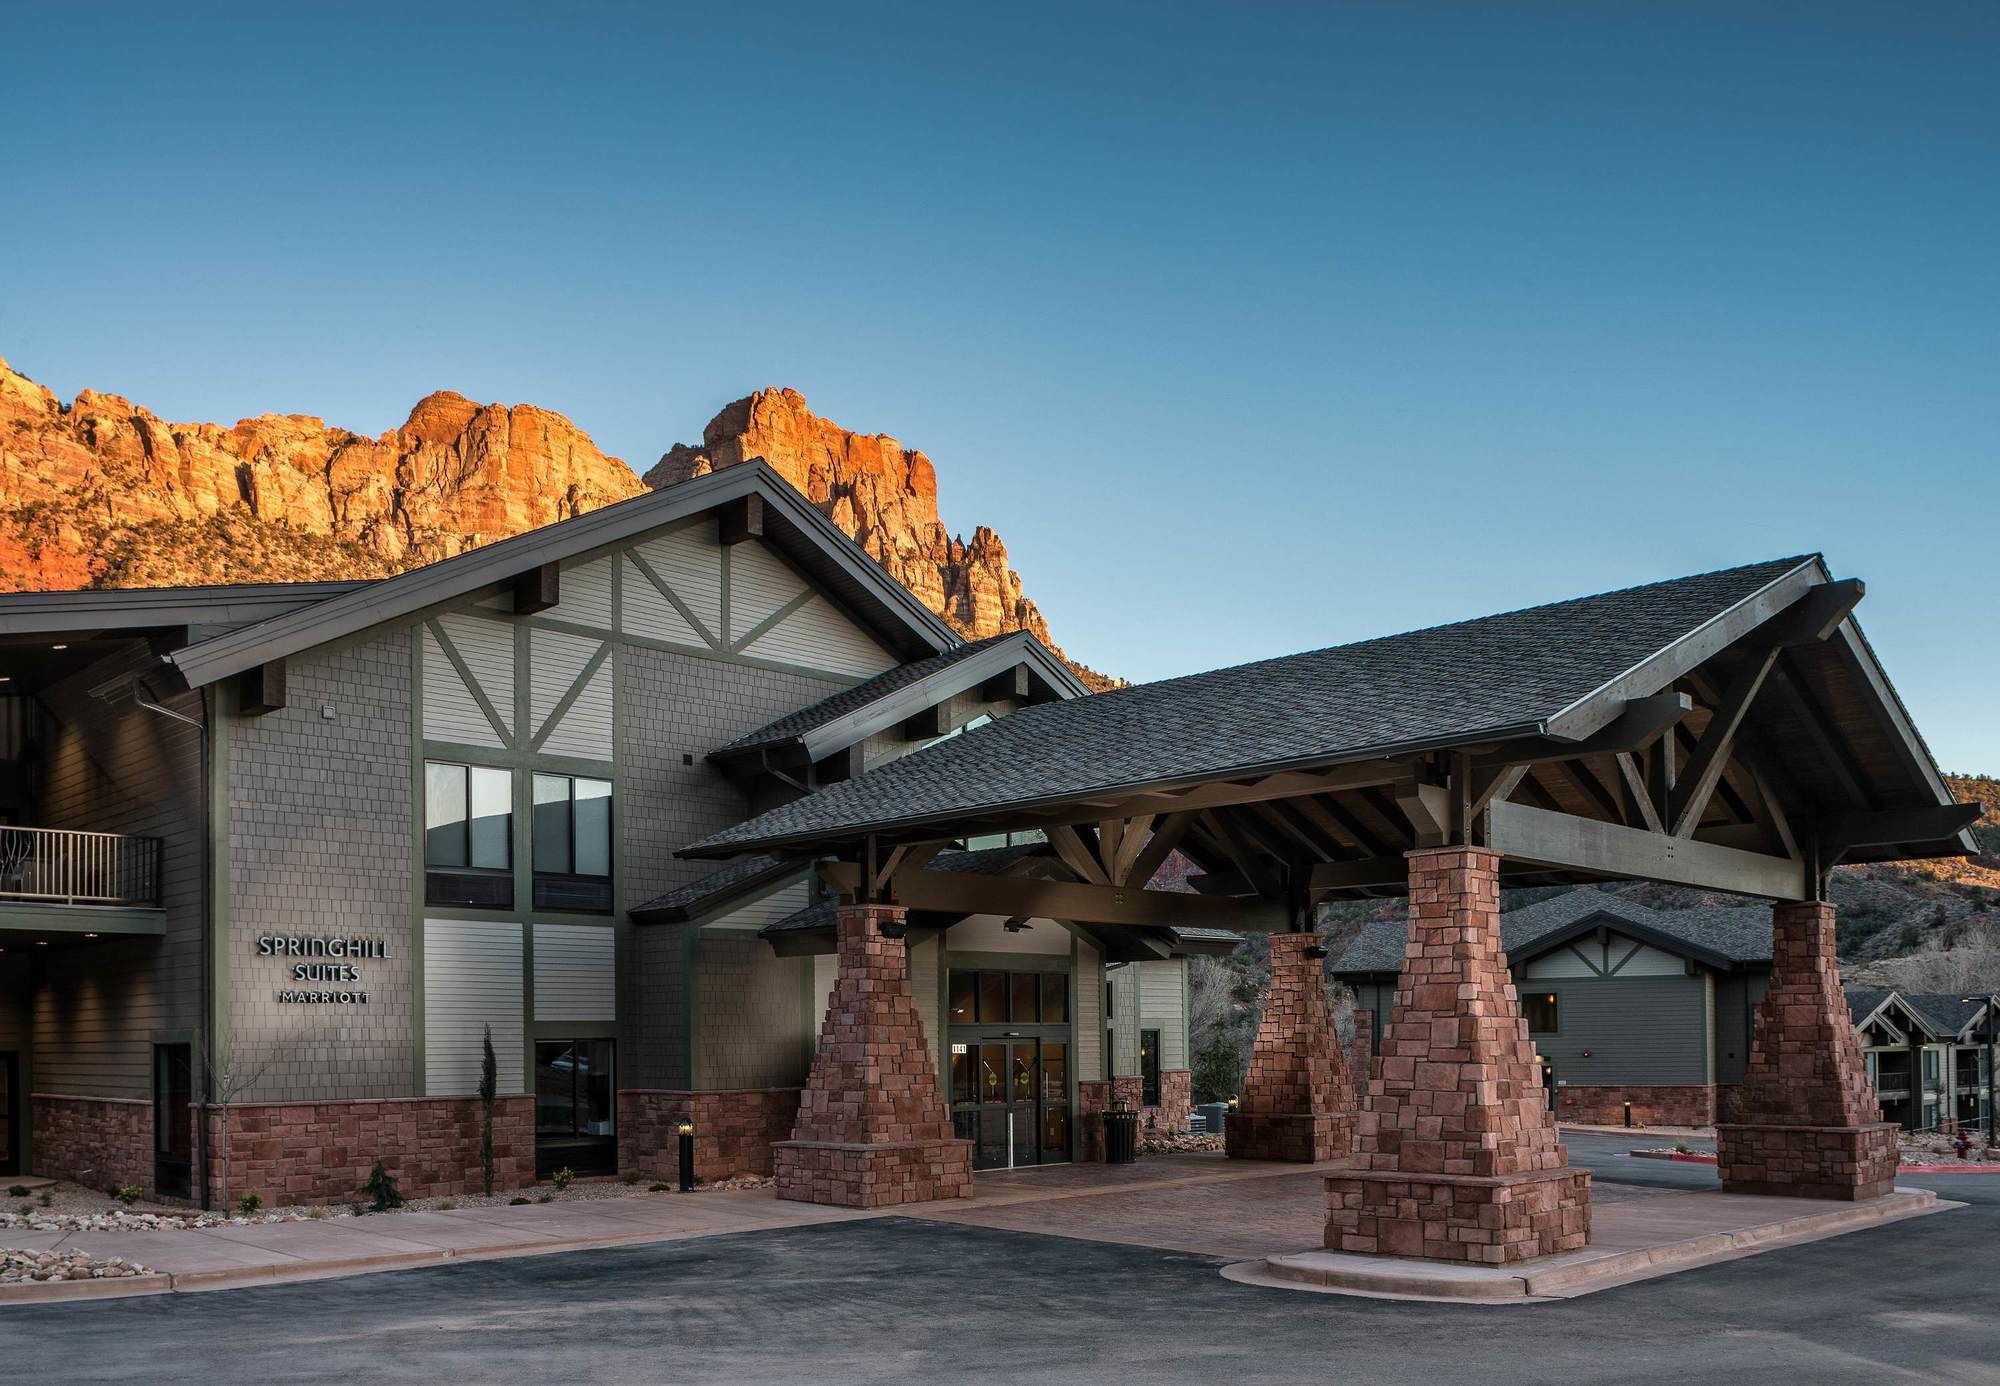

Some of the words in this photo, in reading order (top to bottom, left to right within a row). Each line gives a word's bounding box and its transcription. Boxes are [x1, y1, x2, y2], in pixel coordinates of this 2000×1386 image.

[258, 936, 392, 958] SPRINGHILL
[294, 964, 360, 982] SUITES
[281, 991, 371, 1004] MARRIOTT
